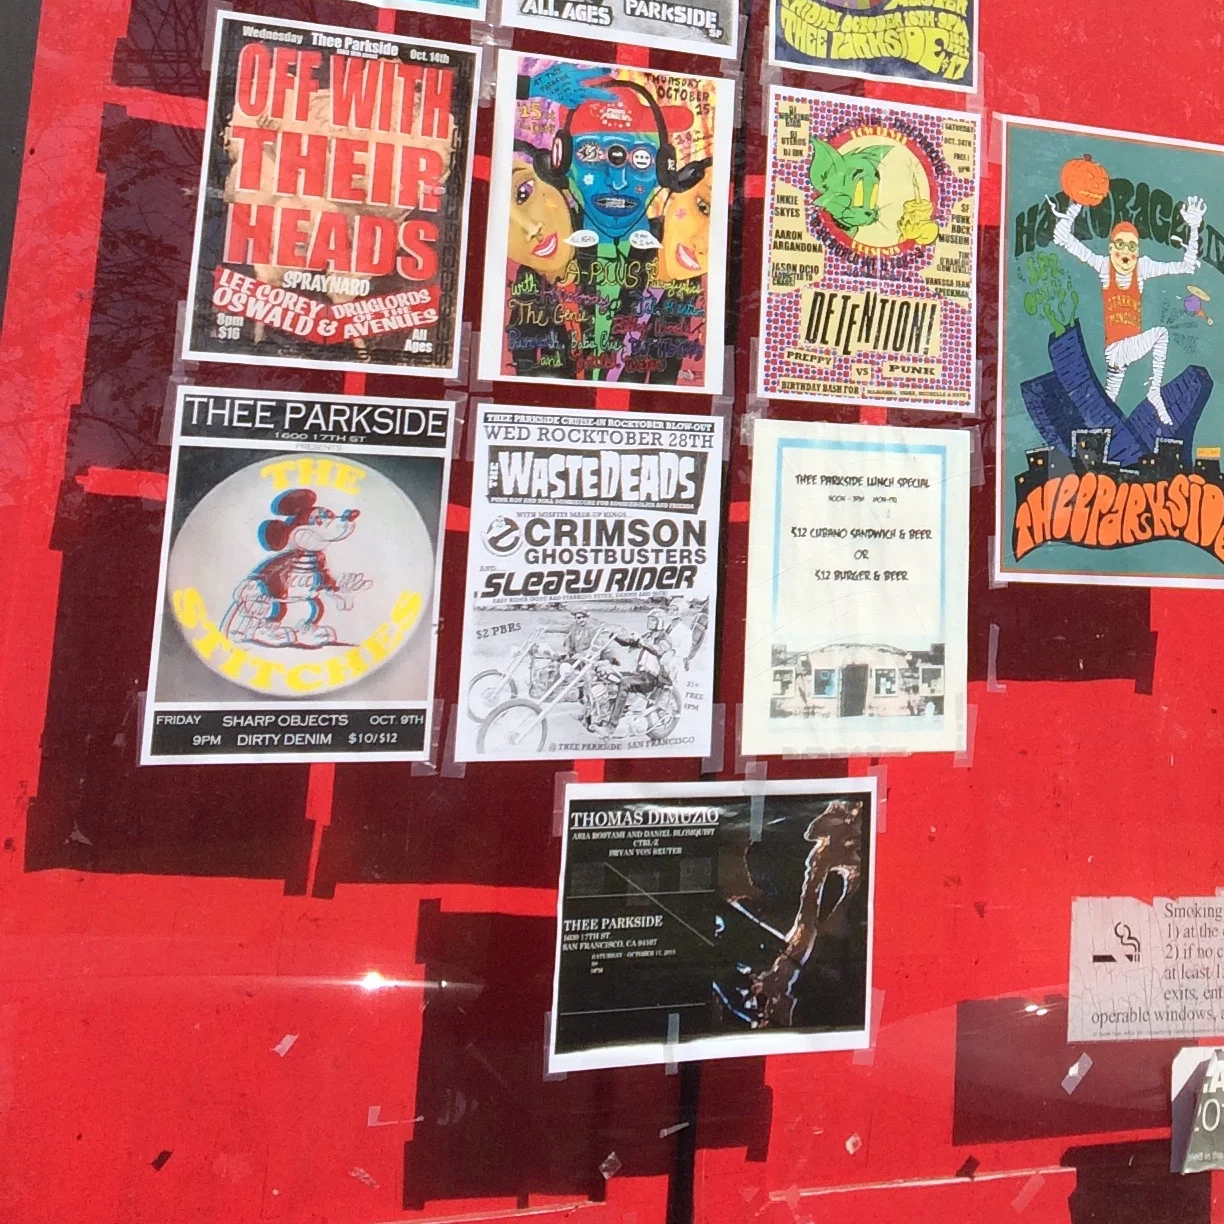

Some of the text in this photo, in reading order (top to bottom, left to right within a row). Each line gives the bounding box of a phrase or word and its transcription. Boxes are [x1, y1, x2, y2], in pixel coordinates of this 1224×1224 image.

[564, 3, 612, 25] AGES
[242, 25, 303, 44] Wednesday
[311, 32, 342, 49] Thee
[344, 36, 399, 56] Parkside
[409, 48, 428, 61] Oct.
[430, 51, 450, 64] 14th
[780, 5, 828, 59] THEE
[830, 25, 951, 74] PARKSIDE
[643, 70, 702, 89] THURSDAY
[234, 41, 323, 123] OFF
[329, 53, 454, 139] WITH
[656, 86, 710, 104] OCTOBER
[229, 126, 446, 213] THEIR
[776, 194, 799, 205] INKIE
[774, 206, 800, 218] SKYES
[951, 214, 970, 224] PUNK
[222, 201, 440, 282] HEADS
[774, 229, 803, 241] AARON
[938, 234, 970, 245] MUSEUM
[772, 240, 823, 254] ARGANDONA
[561, 258, 643, 288] A-PLUS
[282, 269, 371, 297] SPRAYNARD
[218, 268, 326, 319] LEE COREY
[212, 286, 315, 337] OSWALD
[331, 288, 432, 320] DRUGLORDS
[508, 298, 550, 327] The
[216, 313, 244, 328] 8pm
[342, 307, 439, 340] AVENUES
[804, 291, 938, 356] DETENTION!
[218, 327, 241, 340] $16
[404, 339, 433, 353] Ages
[786, 350, 832, 366] PREPPY
[855, 368, 869, 376] VS
[888, 364, 936, 375] PUNK
[781, 379, 822, 392] BIRTHDAY
[185, 396, 448, 438] THEE PARKSIDE
[486, 414, 513, 422] THEE
[513, 415, 560, 425] PARKSIDE
[607, 419, 665, 430] ROCKTOBER
[665, 421, 713, 432] BLOW-OUT
[274, 431, 367, 443] 1600 17TH ST
[484, 425, 714, 449] WED ROCKTOBER 28TH
[295, 443, 342, 452] PRESENTS
[260, 457, 367, 496] THE
[489, 462, 499, 489] THE
[498, 450, 696, 501] WASTEDEADS
[795, 474, 930, 489] THEE PARKSIDE LUNCH SPECIAL
[524, 517, 708, 548] CRIMSON
[791, 526, 933, 540] $12 CUBANO SANDWICH BEER
[524, 547, 708, 565] GHOSTBUSTERS
[853, 549, 869, 560] OR
[480, 564, 699, 599] SLEAZY RIDER
[814, 569, 909, 581] $12 BURGER BEER
[172, 587, 423, 693] STITCHES
[475, 629, 490, 640] $2
[685, 692, 704, 700] FREE
[156, 714, 424, 727] FRIDAY SHARP OBJECTS OCT. 9TH
[192, 733, 398, 746] 9PM DIRTY DENIM $10/$12
[581, 743, 622, 751] PARKSIDE
[627, 740, 645, 749] SAN
[645, 736, 696, 749] FRANCISCO
[571, 809, 720, 827] THOMAS DIMUZIO
[626, 830, 643, 838] AND
[1164, 902, 1222, 922] Smoking
[563, 915, 664, 932] THEE PARKSIDE
[1167, 923, 1180, 939] 1)
[1183, 925, 1198, 938] at
[1199, 922, 1219, 937] the
[562, 939, 636, 951] SAN CA
[1165, 943, 1213, 961] 2) no
[1164, 966, 1177, 980] at
[1180, 964, 1210, 980] least
[1091, 1006, 1150, 1028] operable
[1153, 1004, 1217, 1022] windows,
[1205, 1151, 1211, 1160] in
[1212, 1150, 1224, 1160] the
